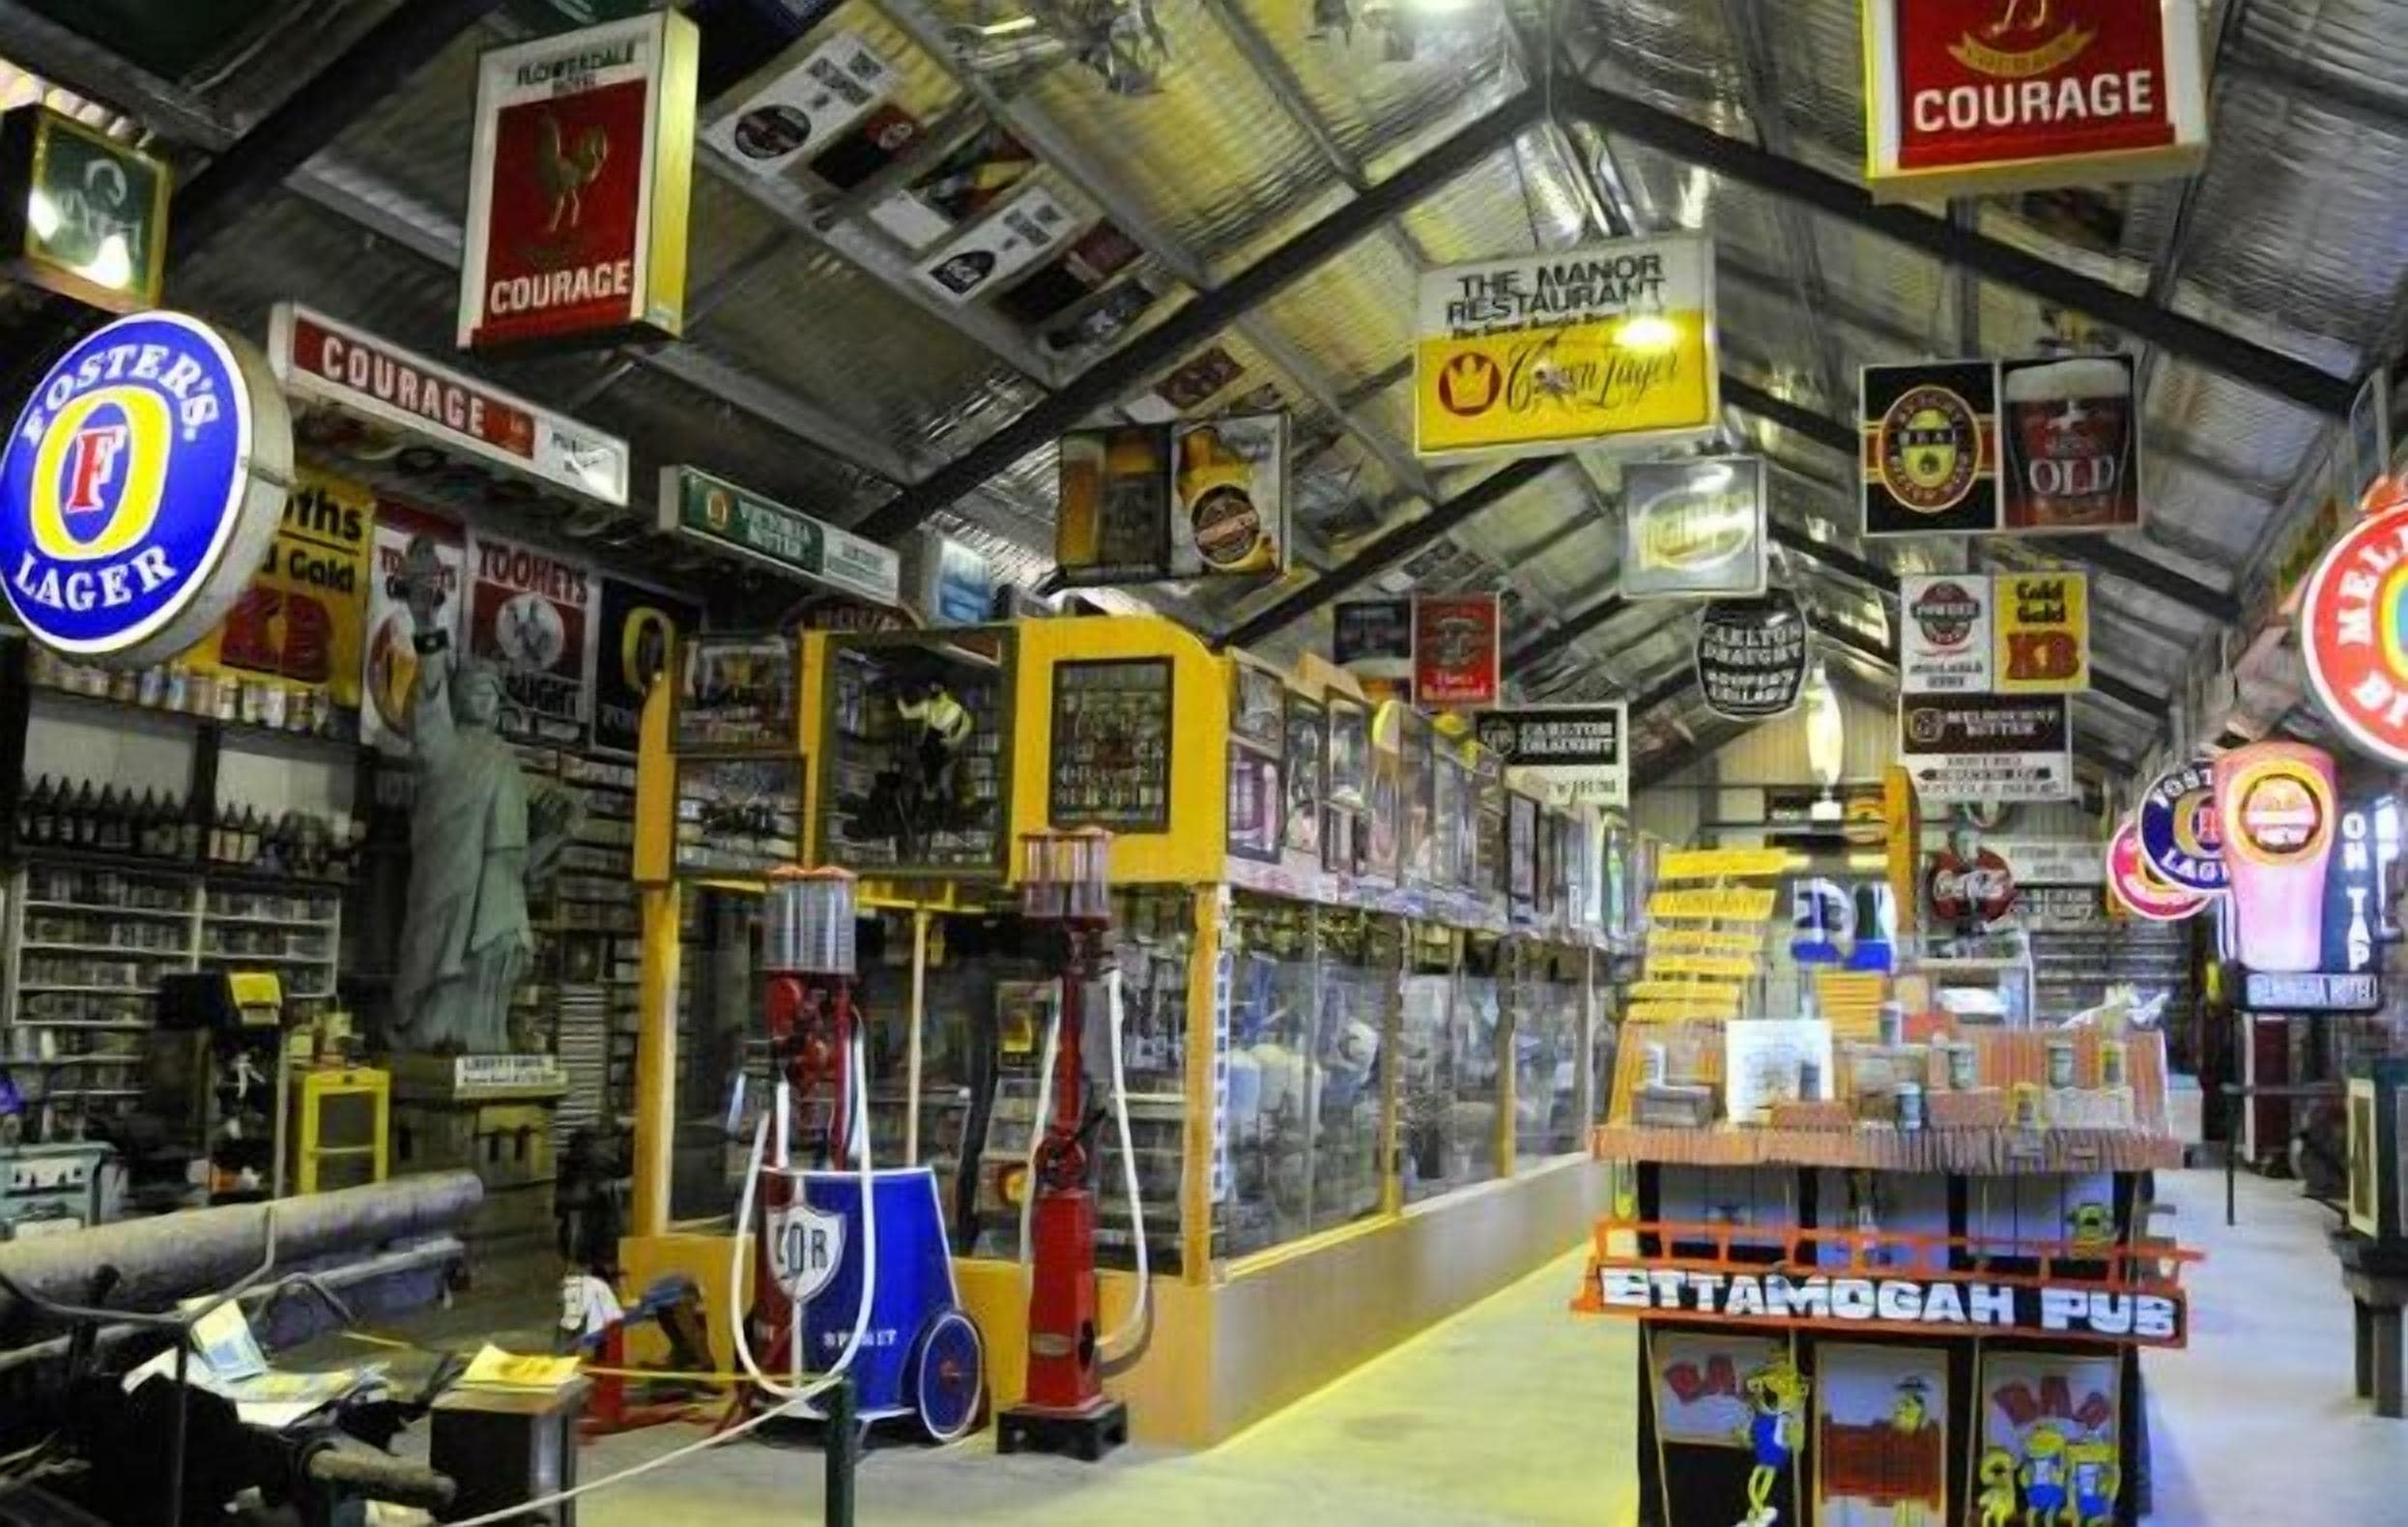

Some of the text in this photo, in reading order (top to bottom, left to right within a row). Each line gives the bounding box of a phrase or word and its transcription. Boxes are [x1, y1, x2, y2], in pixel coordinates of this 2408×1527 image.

[1913, 70, 2153, 132] COURAGE
[490, 259, 632, 314] COURAGE
[1445, 276, 1667, 326] RESTAURANT
[1457, 254, 1664, 298] THE MANOR
[322, 336, 485, 434] COURAGE
[2029, 455, 2115, 495] OLD
[14, 545, 178, 611] LAGER
[476, 540, 588, 608] TOOHEYS
[1602, 1266, 2177, 1338] ETTAMOGAH PUB
